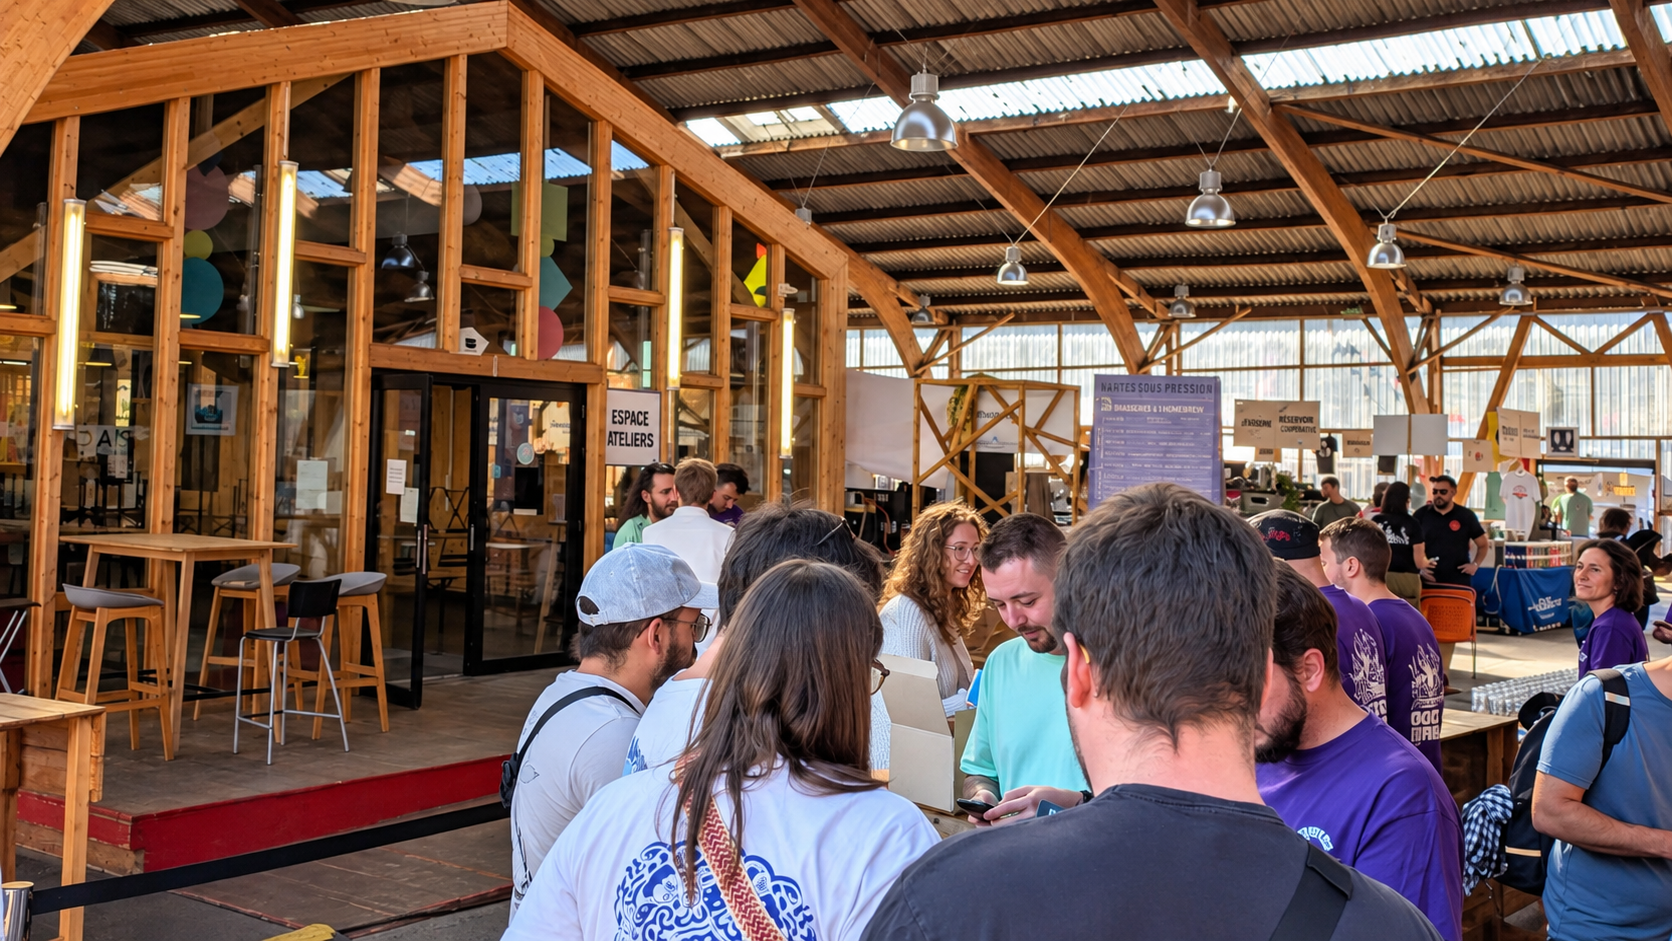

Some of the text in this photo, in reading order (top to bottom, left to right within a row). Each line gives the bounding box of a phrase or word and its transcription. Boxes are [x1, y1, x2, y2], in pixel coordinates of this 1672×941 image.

[1138, 383, 1162, 393] SOUS
[1165, 384, 1213, 394] PRESSION
[612, 409, 649, 426] ESPACE
[607, 431, 654, 448] ATELIERS
